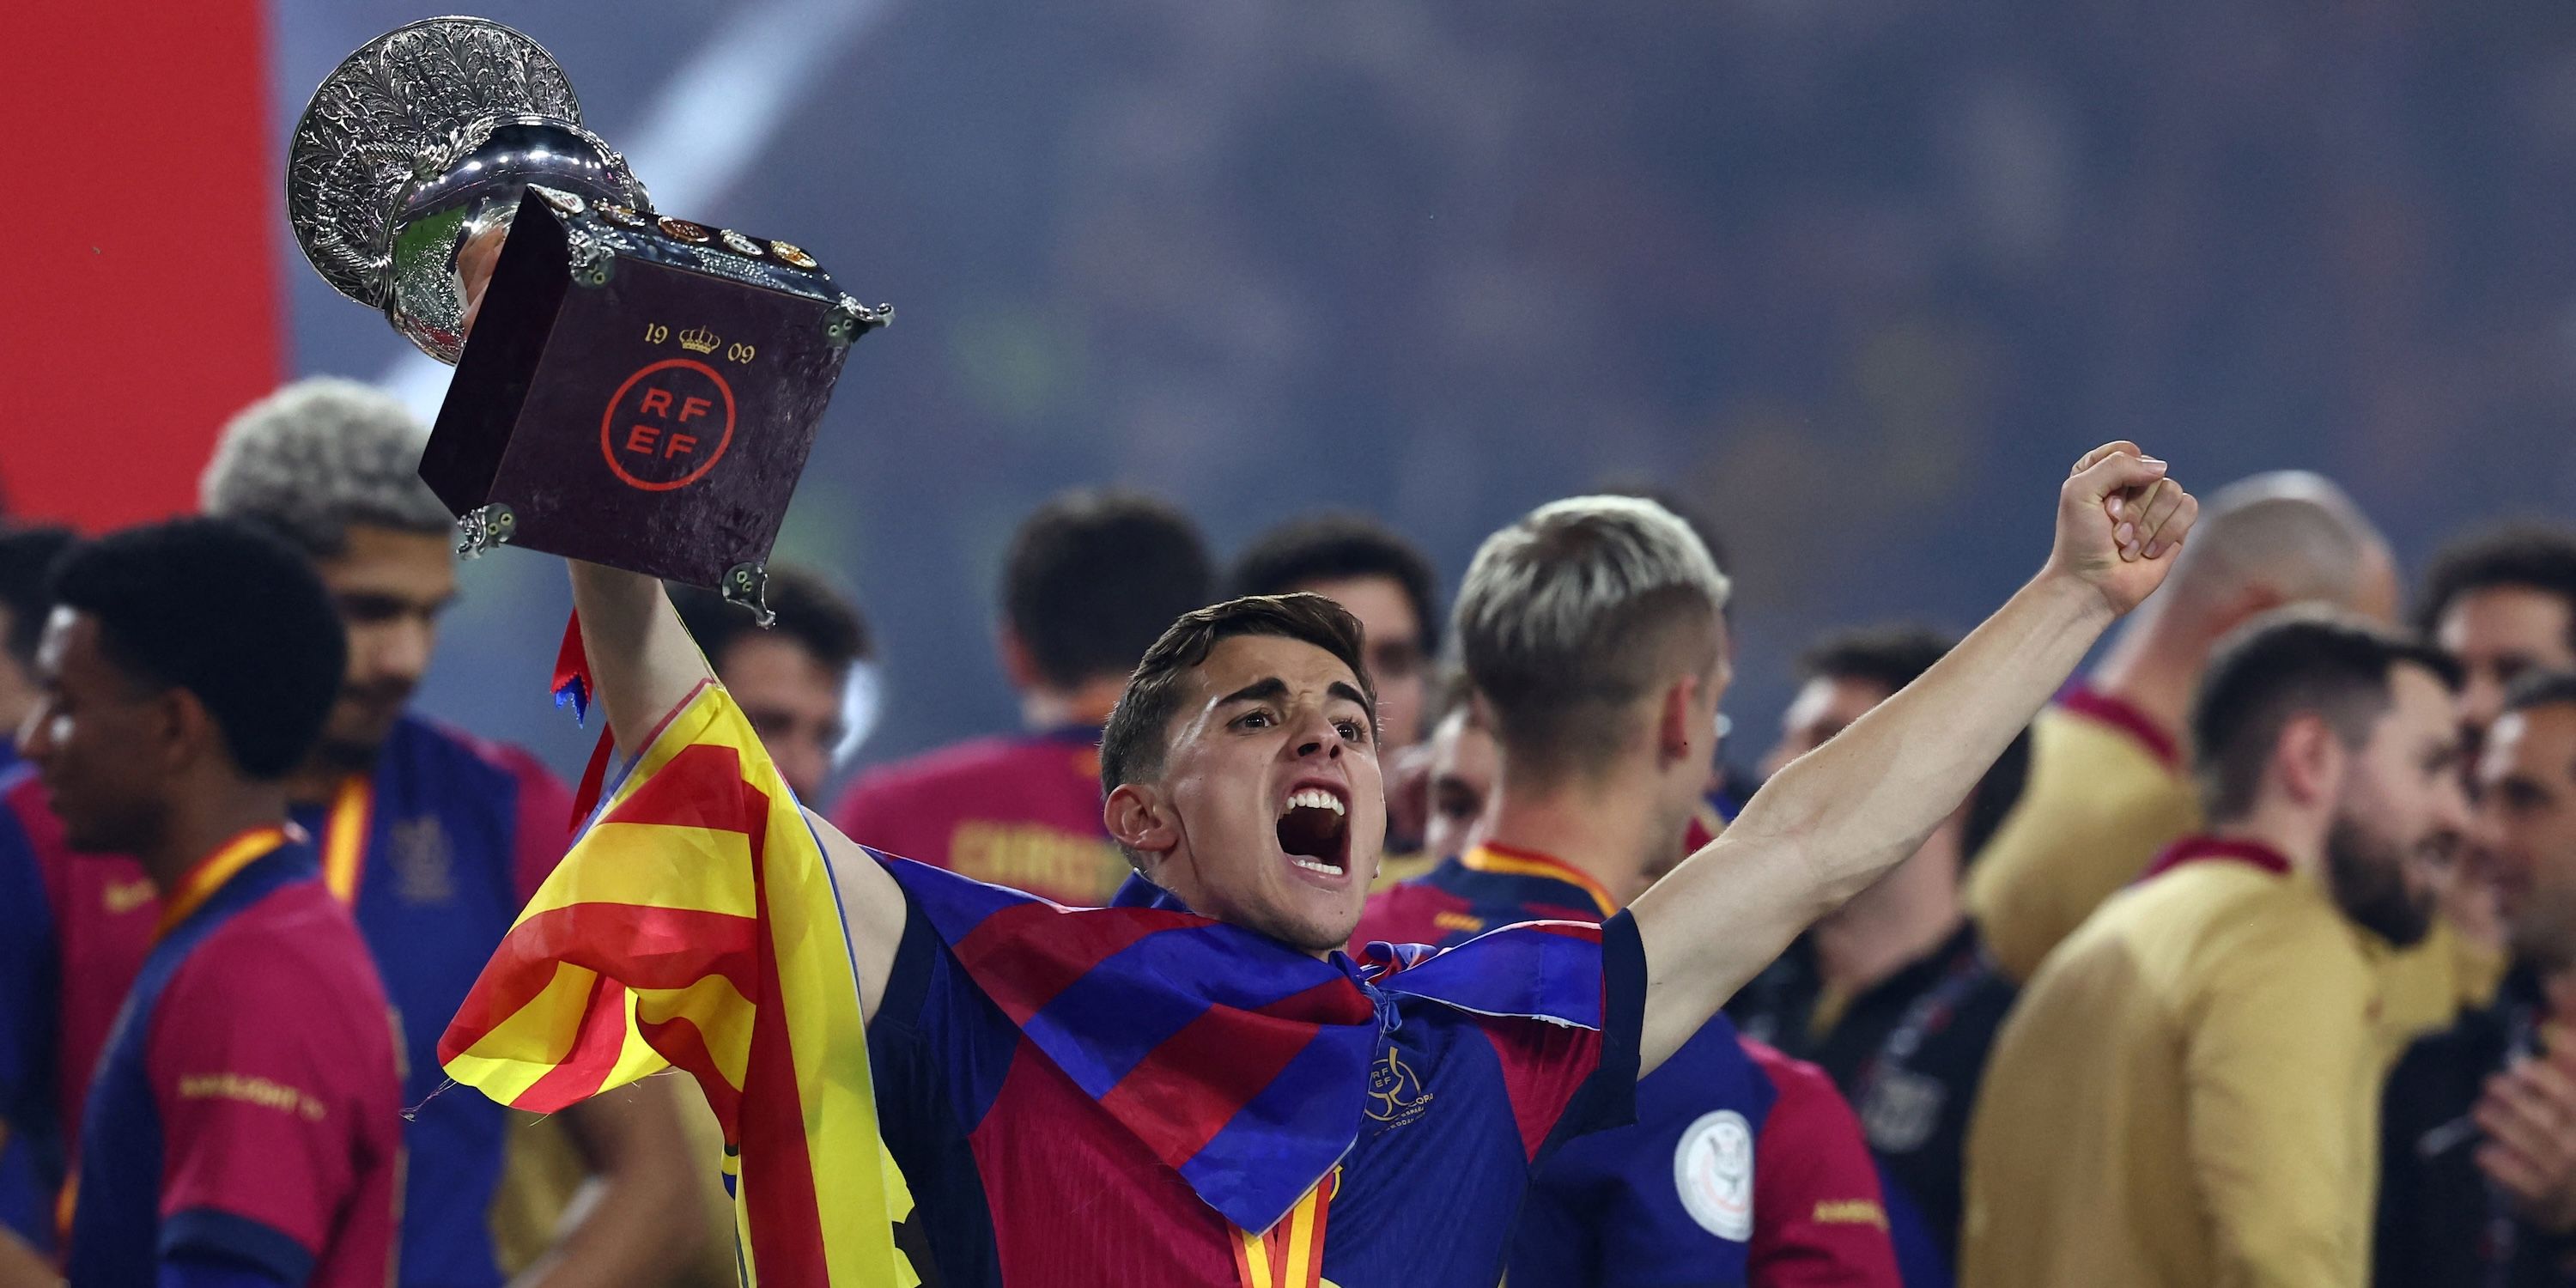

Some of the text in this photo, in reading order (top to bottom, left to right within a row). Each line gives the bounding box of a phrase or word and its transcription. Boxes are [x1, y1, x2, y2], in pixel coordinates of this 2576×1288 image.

[644, 322, 756, 364] 19 09
[640, 387, 713, 422] RF
[626, 424, 698, 459] EF
